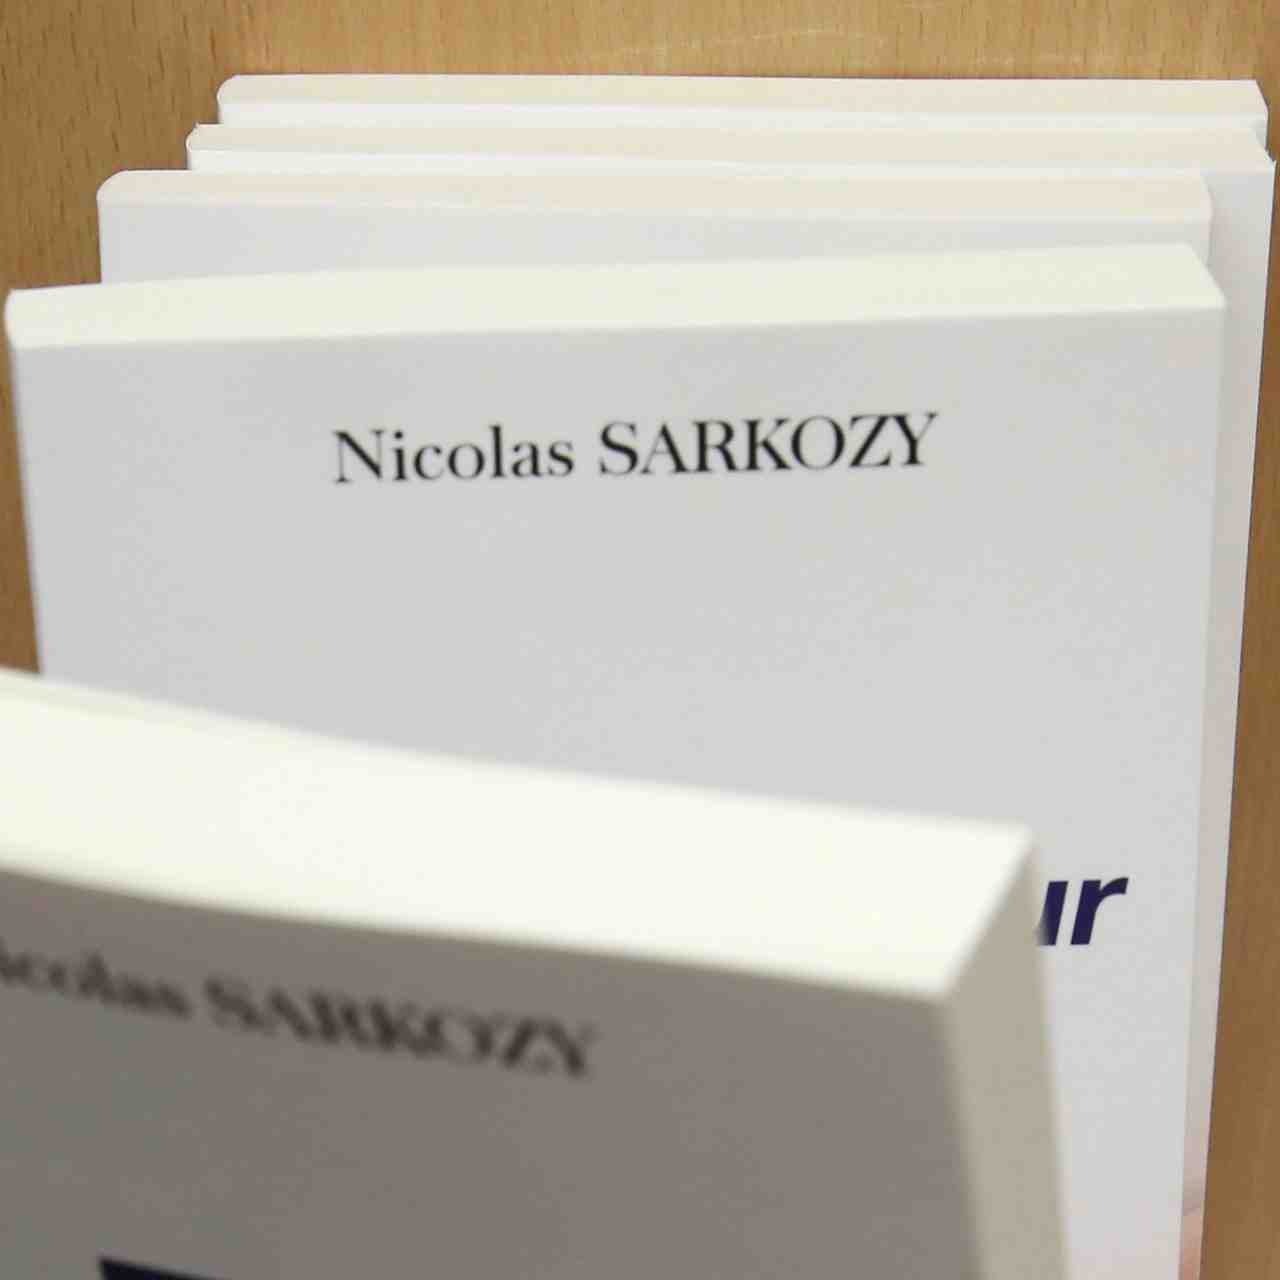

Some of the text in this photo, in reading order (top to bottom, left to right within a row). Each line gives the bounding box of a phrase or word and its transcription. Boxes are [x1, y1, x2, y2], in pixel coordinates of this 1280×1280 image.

[334, 411, 938, 485] Nicolas SARKOZY
[204, 975, 594, 1078] SARKOZY
